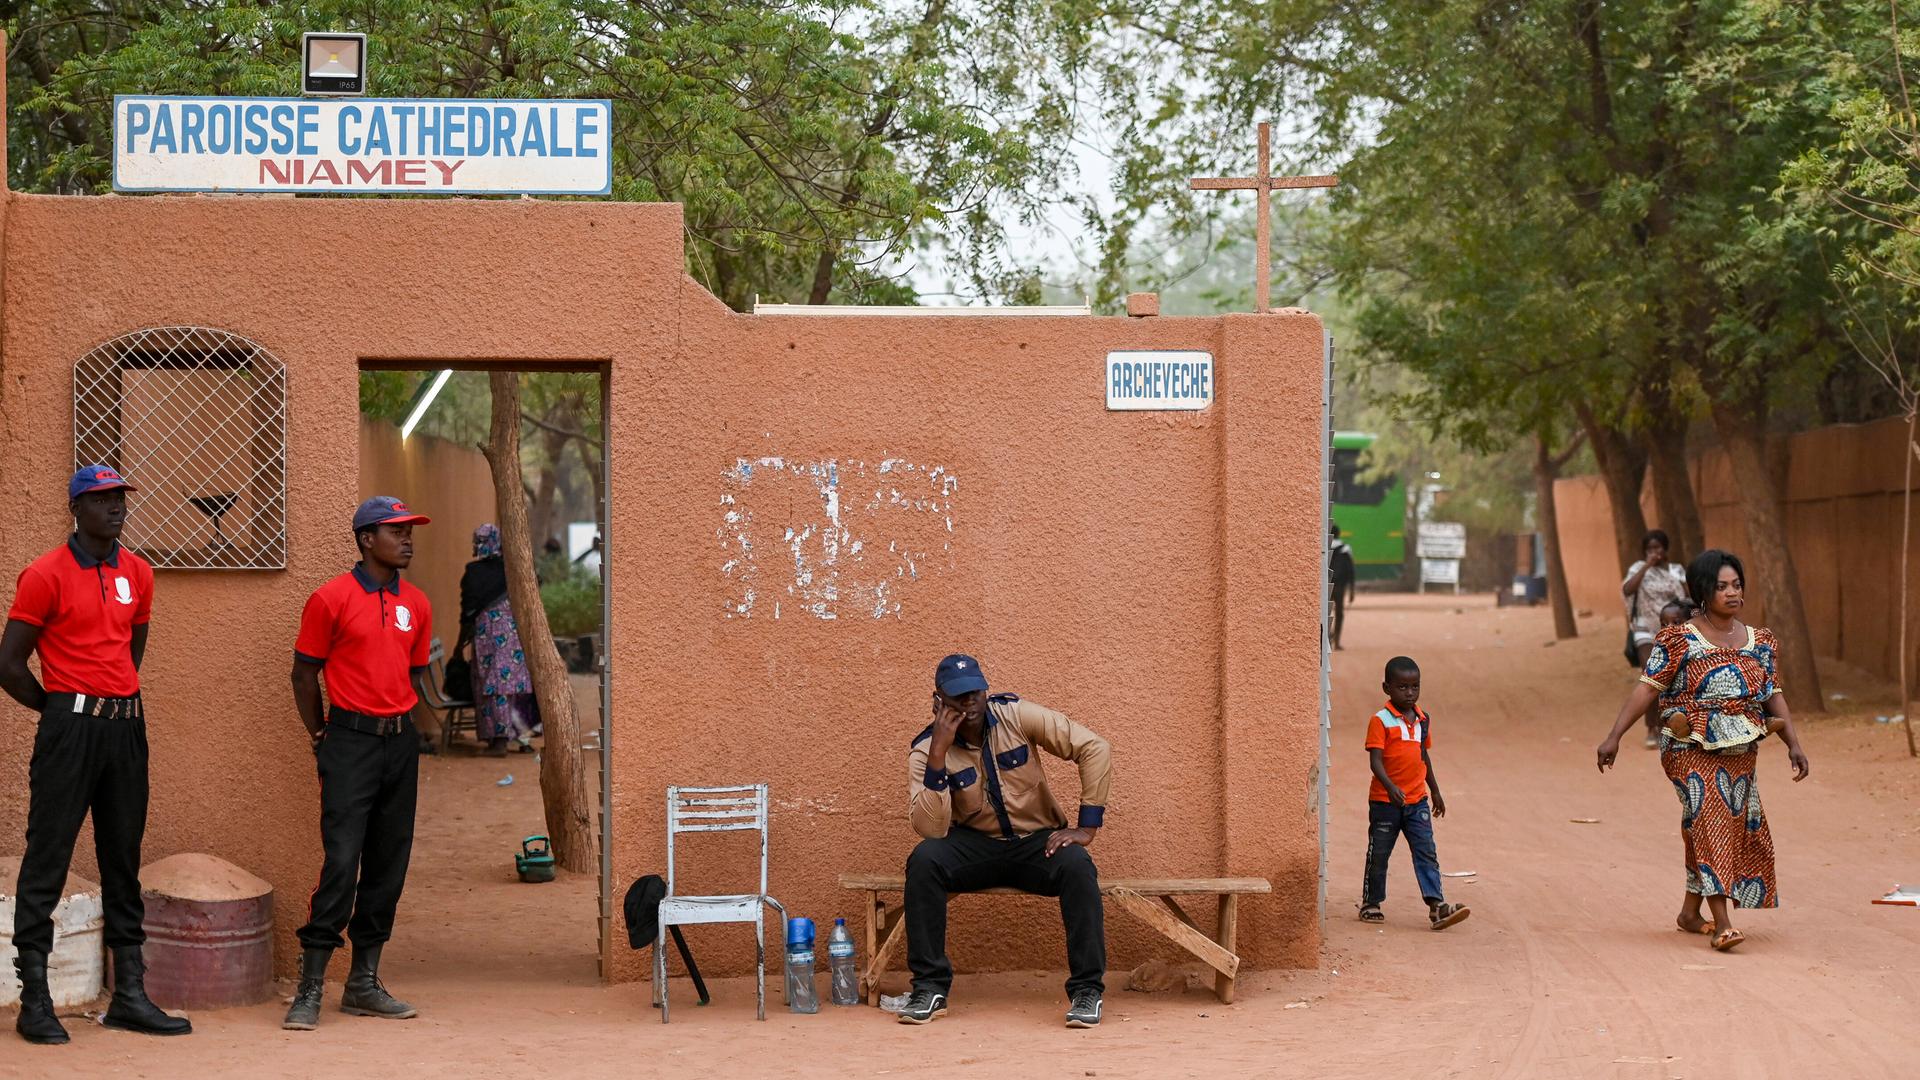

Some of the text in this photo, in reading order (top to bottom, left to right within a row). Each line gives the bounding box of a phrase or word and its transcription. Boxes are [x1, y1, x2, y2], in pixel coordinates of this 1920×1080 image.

[339, 81, 356, 89] IP65
[126, 103, 598, 157] PAROISSE CATHEDRALE
[259, 159, 466, 186] NIAMEY
[1112, 362, 1208, 398] ARCHEVECHE
